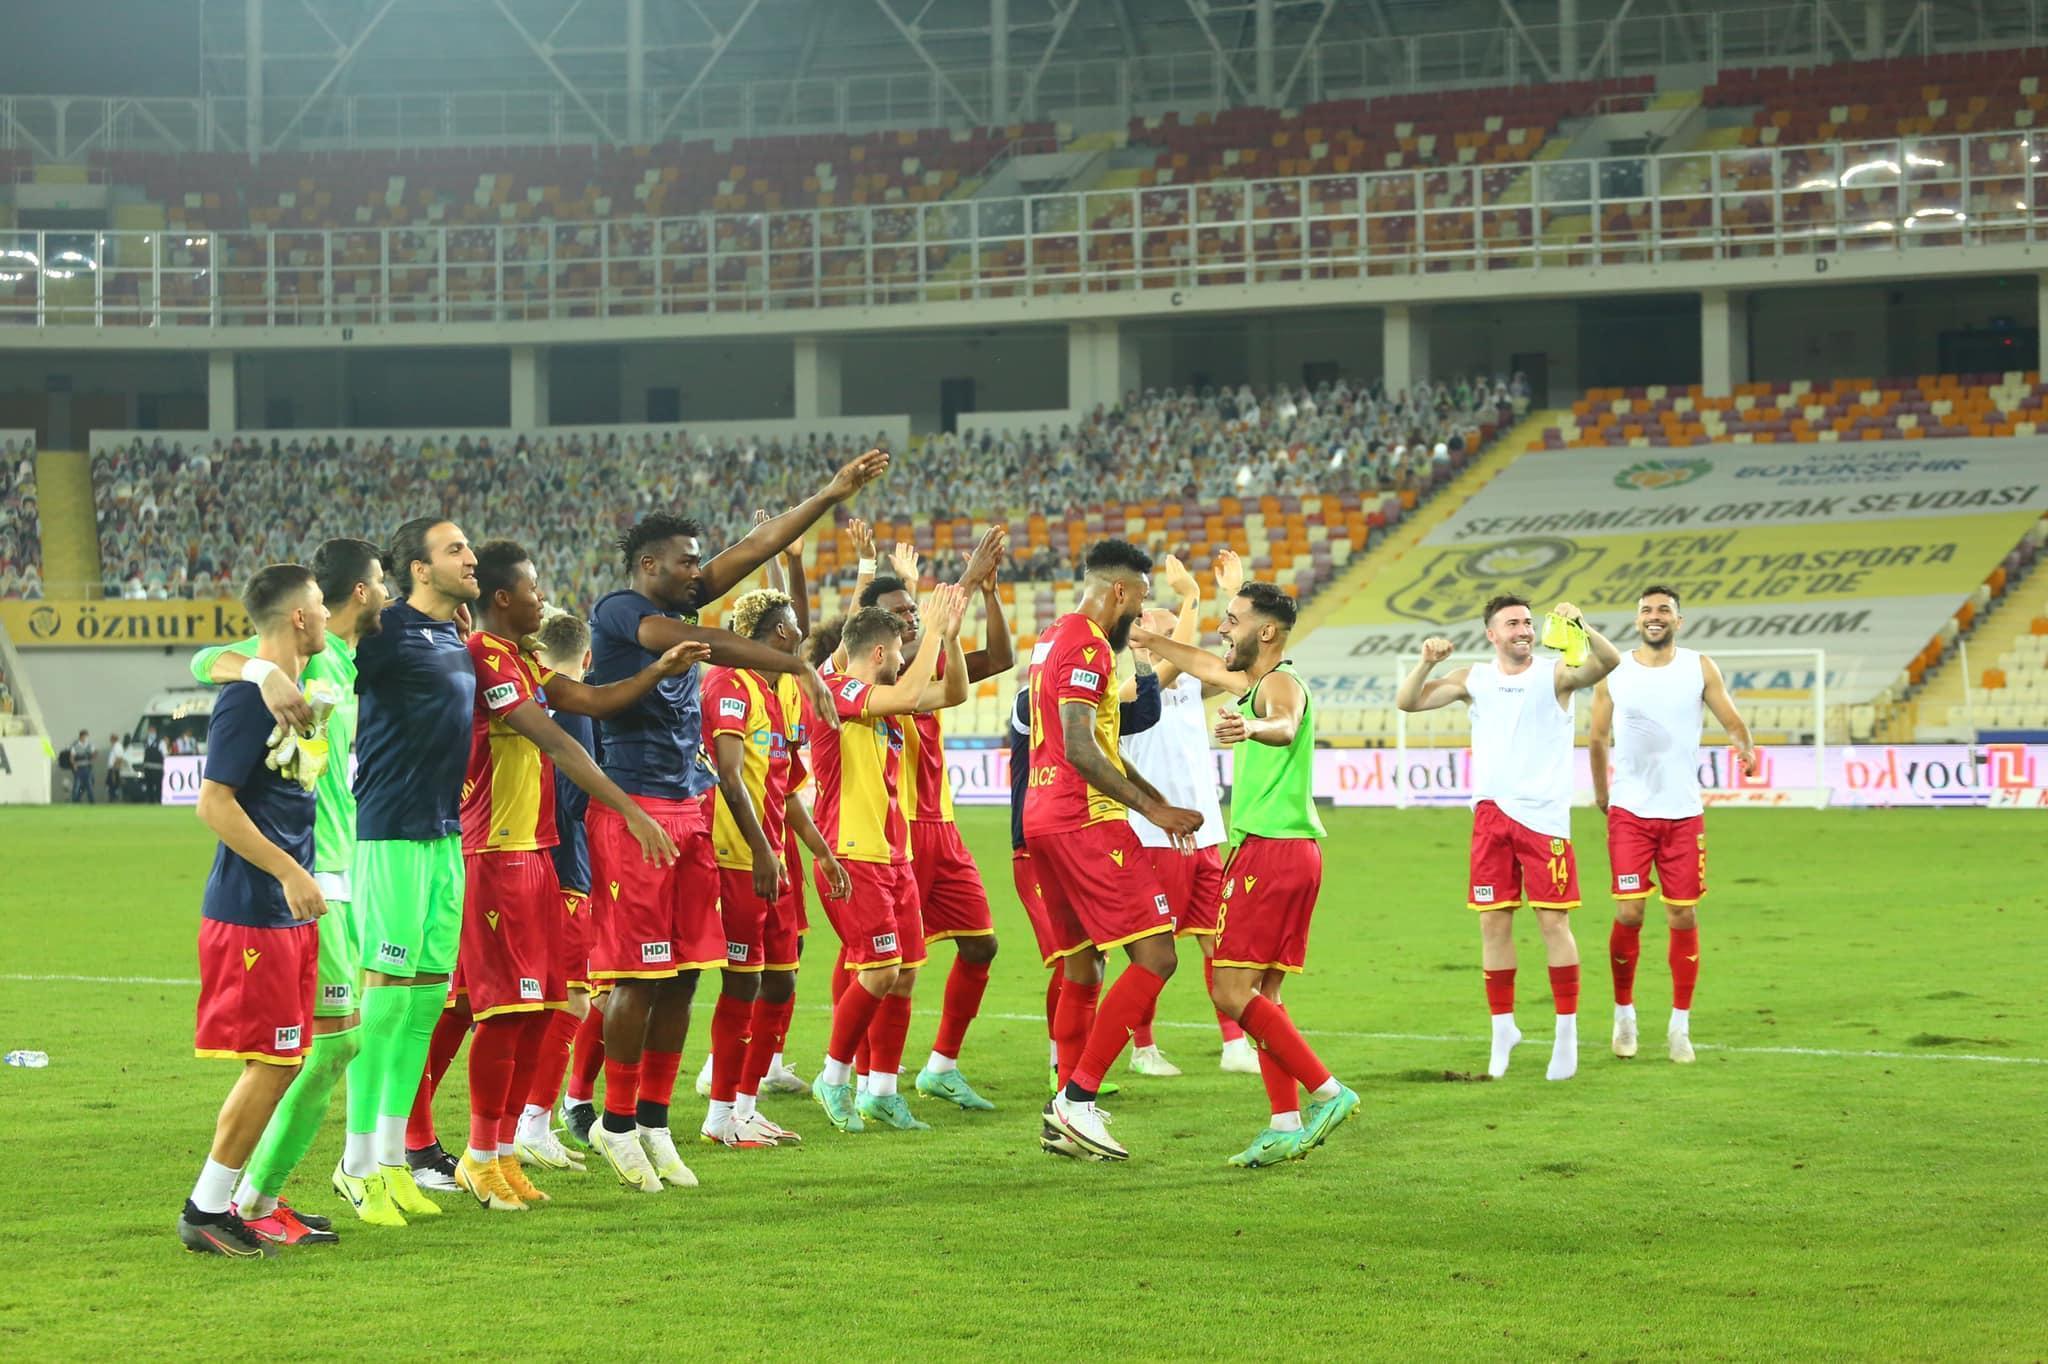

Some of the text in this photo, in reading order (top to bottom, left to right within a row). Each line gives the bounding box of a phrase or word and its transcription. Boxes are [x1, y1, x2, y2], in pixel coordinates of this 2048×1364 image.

[1815, 258, 1828, 273] D
[1171, 291, 1183, 306] C
[1703, 496, 1846, 523] ORTAK
[1849, 484, 2039, 513] SEVDASI
[76, 605, 205, 639] öznur
[487, 685, 514, 703] HDI
[722, 699, 744, 713] HDI
[1547, 857, 1568, 884] 14
[1619, 875, 1638, 885] HDI
[875, 935, 895, 947] HDI
[381, 943, 406, 958] HDI
[644, 943, 669, 956] HDI
[325, 985, 348, 999] HDI
